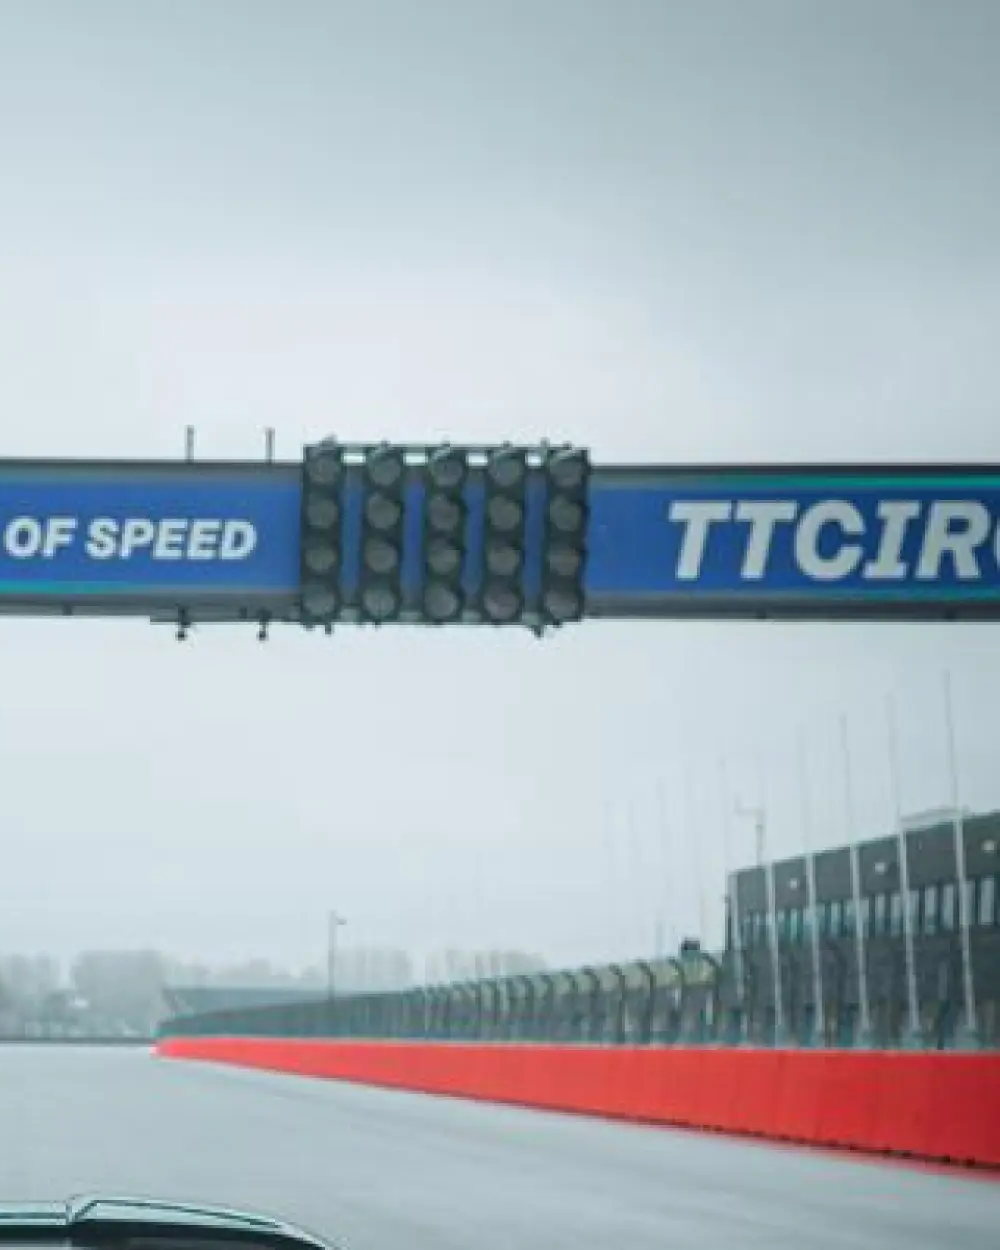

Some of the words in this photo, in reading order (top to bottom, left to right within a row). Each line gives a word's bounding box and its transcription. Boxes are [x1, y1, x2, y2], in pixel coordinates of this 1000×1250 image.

[4, 517, 78, 559] OF
[85, 518, 258, 560] SPEED
[668, 501, 1000, 580] TTCIR
